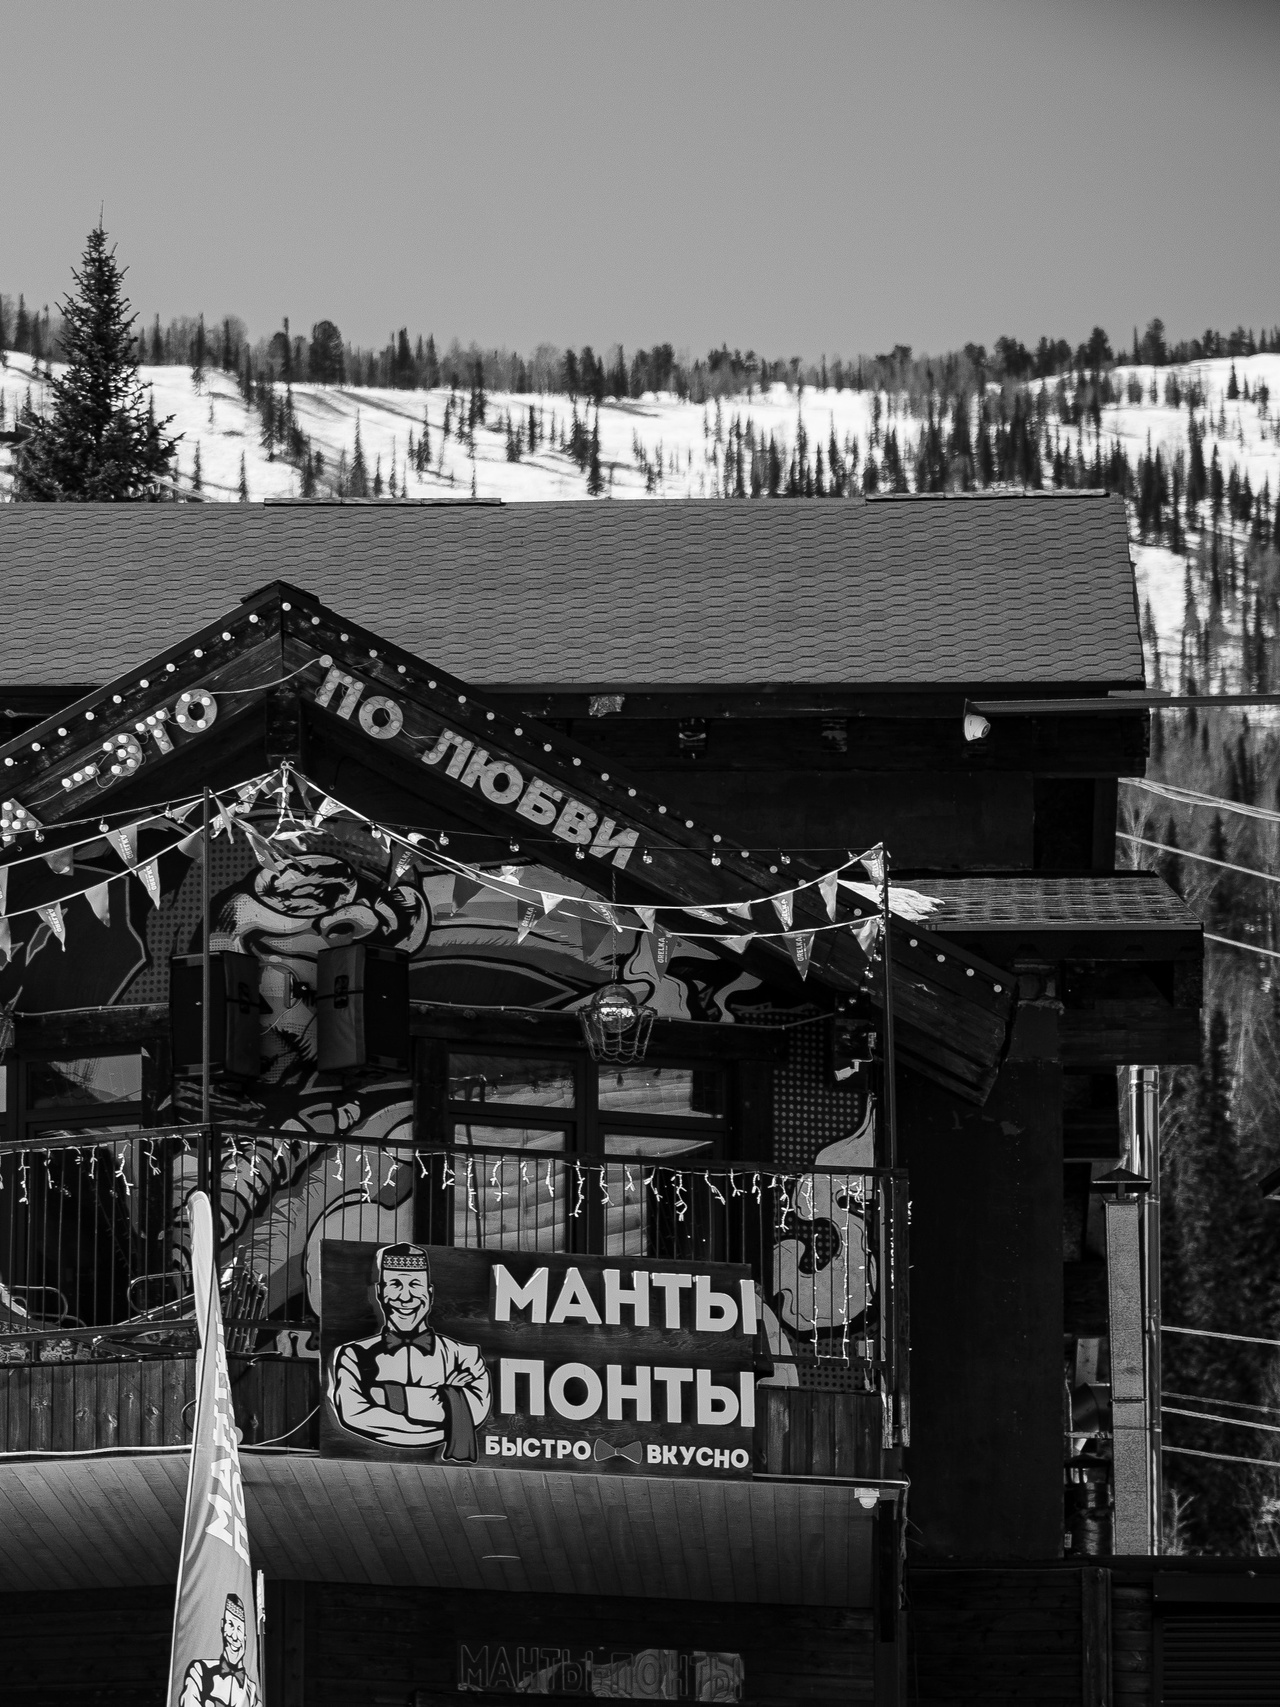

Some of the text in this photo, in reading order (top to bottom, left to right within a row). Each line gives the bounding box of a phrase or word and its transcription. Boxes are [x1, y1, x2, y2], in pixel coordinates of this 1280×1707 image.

[314, 665, 404, 740] ПО
[421, 728, 640, 870] ЛЮБВИ
[492, 1264, 758, 1335] МАНТЫ
[500, 1358, 756, 1428] ПОНТЫ
[485, 1435, 749, 1469] БЫСТРО ВКУСНО
